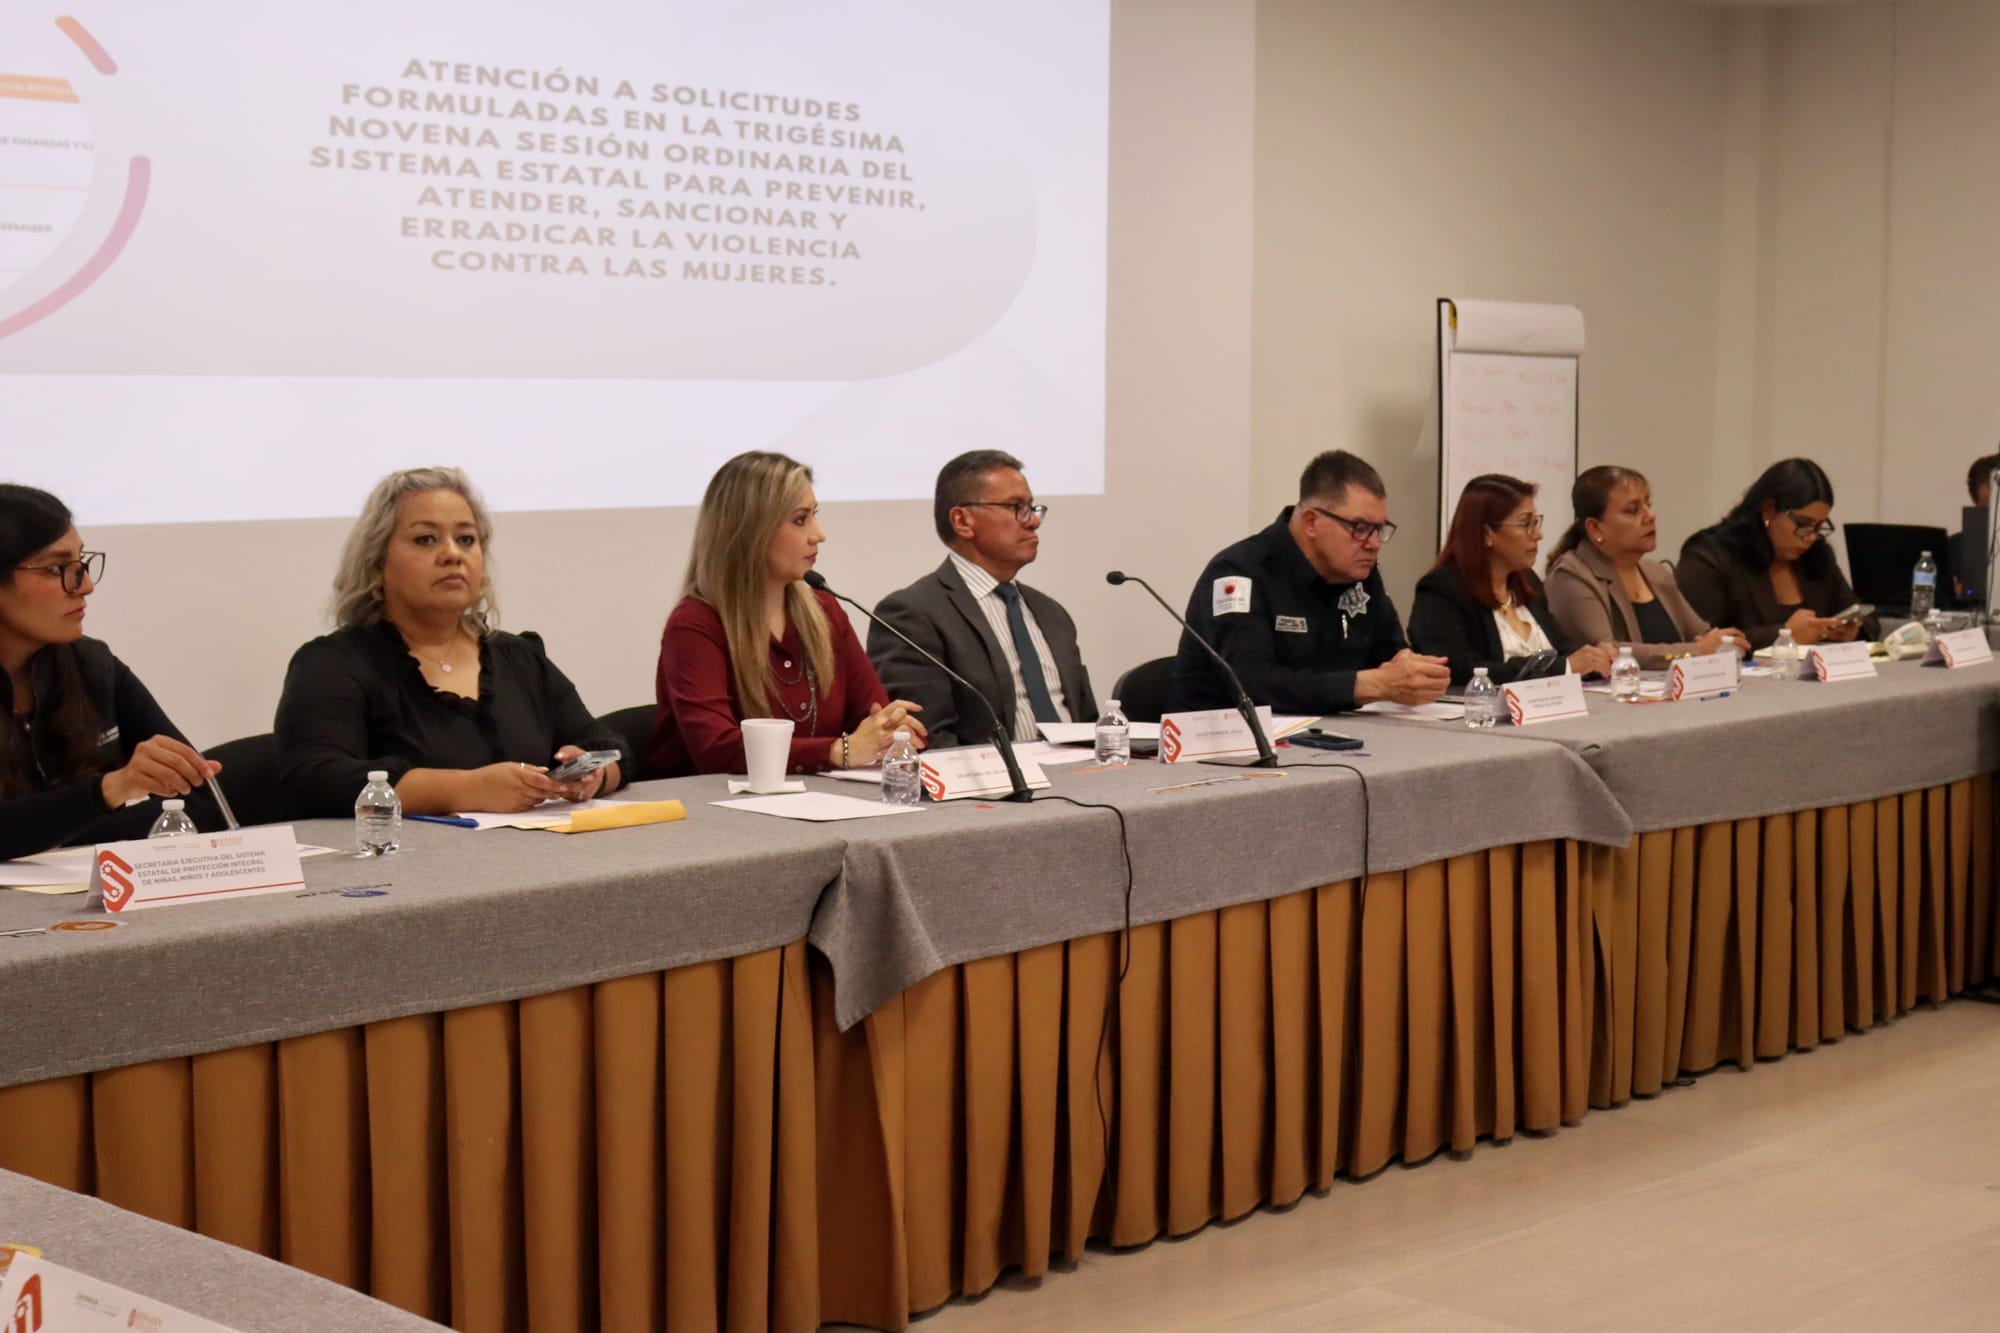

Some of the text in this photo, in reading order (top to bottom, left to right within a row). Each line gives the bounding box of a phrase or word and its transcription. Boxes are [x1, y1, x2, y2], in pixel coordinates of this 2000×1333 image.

[401, 58, 860, 122] ATENCIÓN A SOLICITUDES
[342, 84, 904, 154] FORMULADAS EN LA TRIGÉSIMA
[329, 115, 912, 181] NOVENA SESIÓN ORDINARIA DEL
[309, 146, 925, 212] SISTEMA ESTATAL PARA PREVENIR,
[417, 186, 849, 231] ATENDER, SANCIONAR Y
[401, 216, 861, 259] ERRADICAR LA VIOLENCIA
[431, 250, 836, 286] CONTRA LAS MUJERES.
[138, 859, 265, 878] ESTATAL DE PROTECCIÓN INTEGRAL
[142, 878, 152, 886] DE
[154, 875, 179, 884] NIÑAS,
[180, 871, 203, 881] NIÑOS
[211, 866, 266, 877] ADOLESCENTES
[181, 855, 219, 865] EJECUTIVA
[220, 853, 235, 861] DEL
[236, 850, 266, 859] SISTEMA
